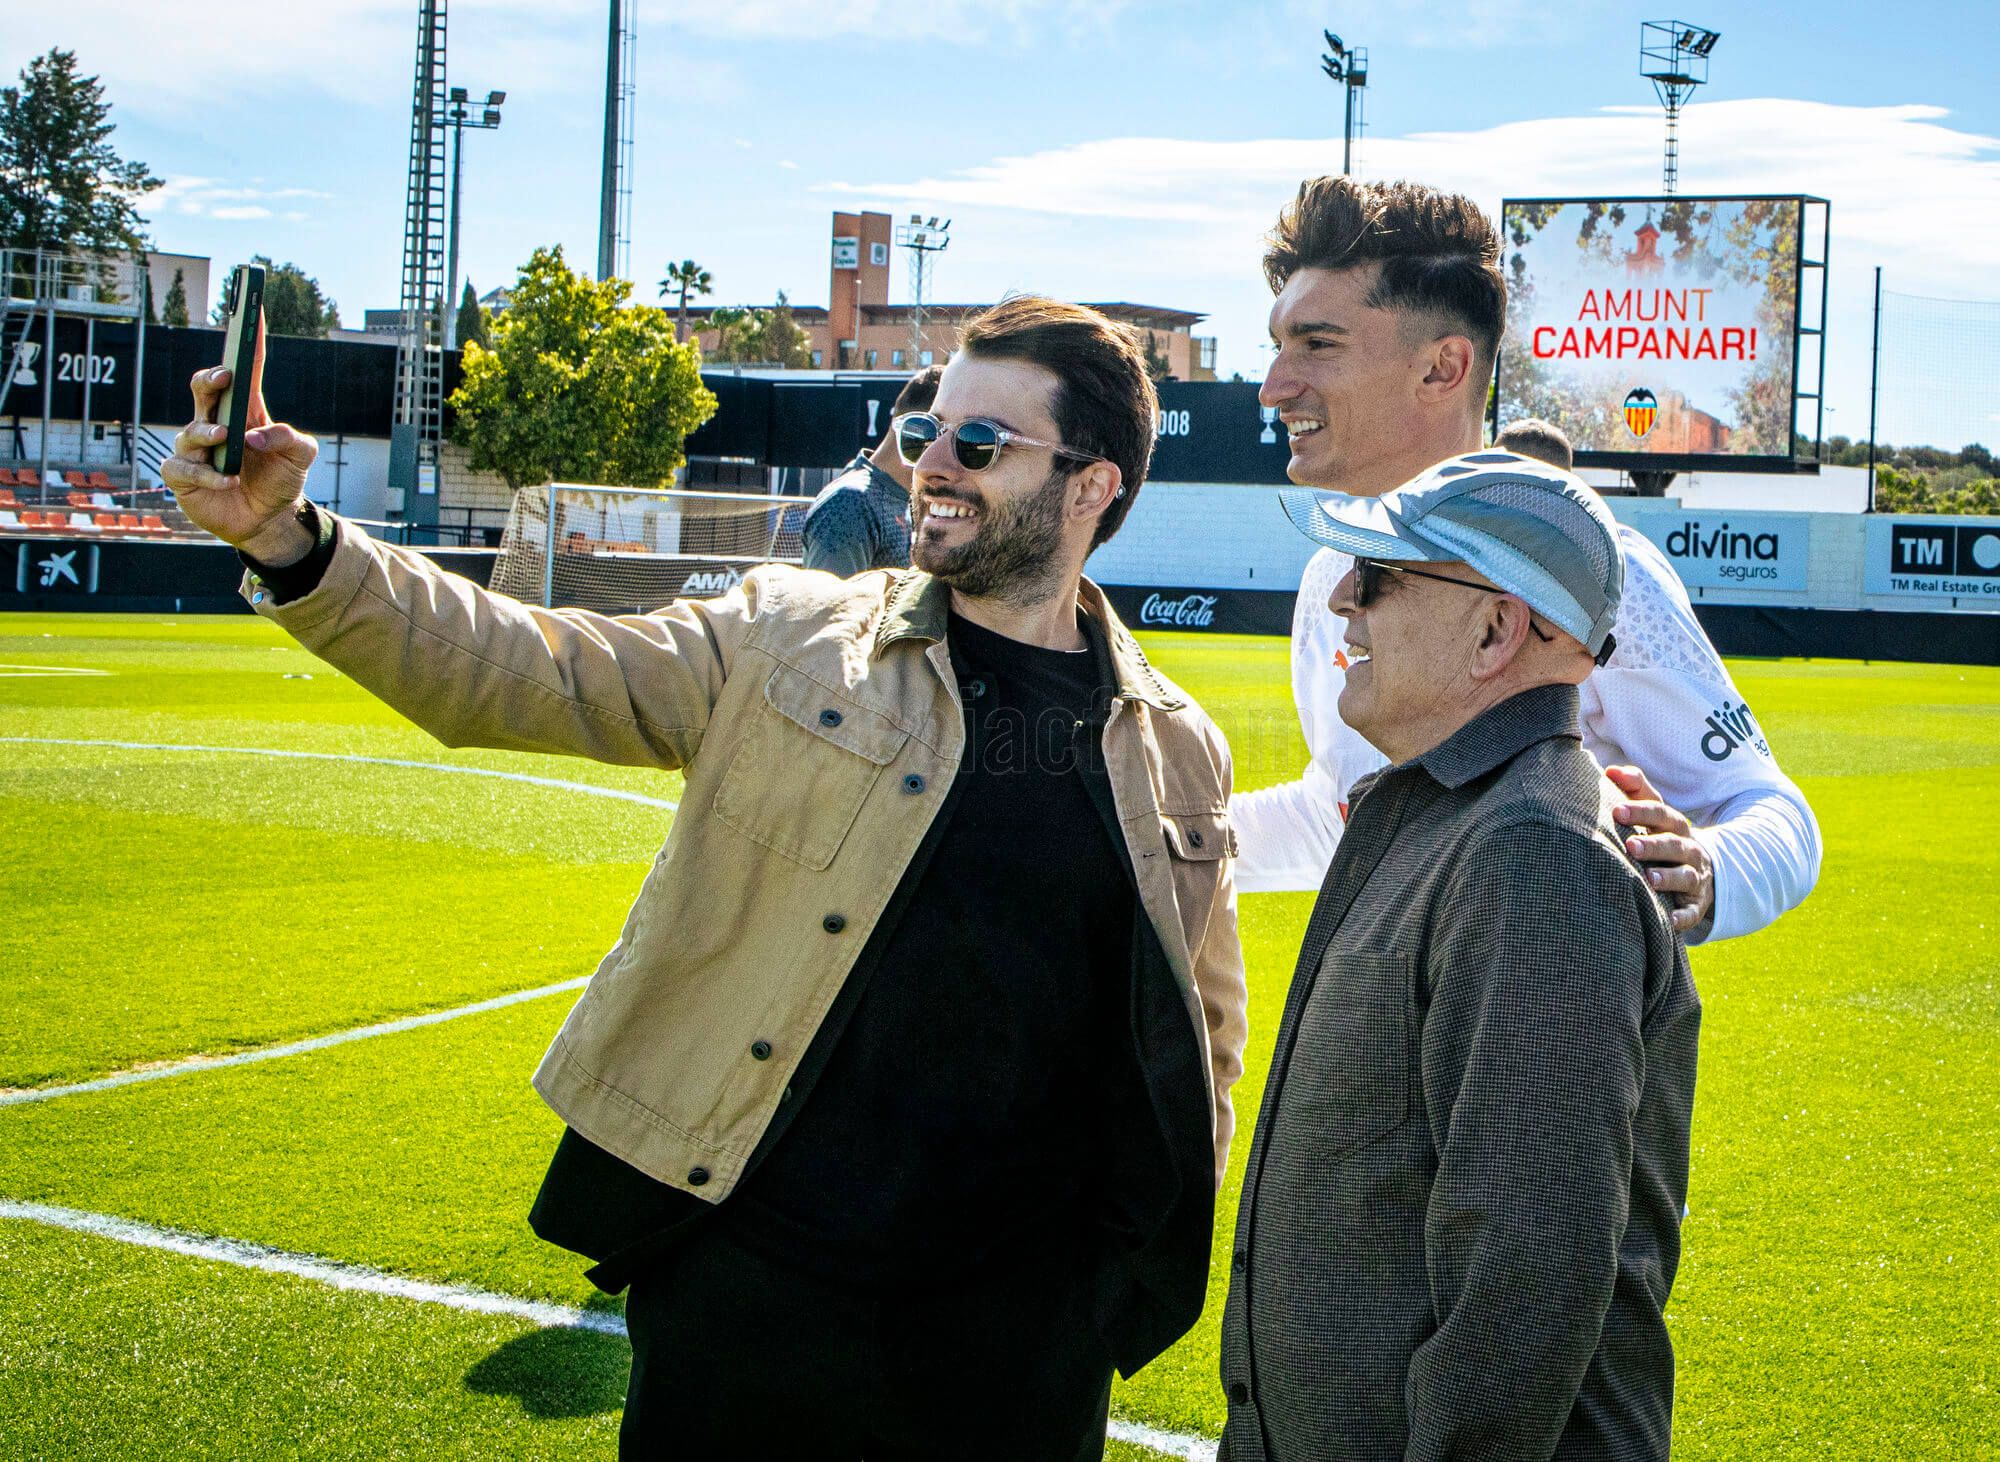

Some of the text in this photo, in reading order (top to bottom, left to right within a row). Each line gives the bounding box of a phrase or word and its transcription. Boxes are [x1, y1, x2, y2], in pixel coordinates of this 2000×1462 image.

[1578, 288, 1713, 322] AMUNT
[1532, 326, 1758, 361] CAMPANAR!
[57, 353, 116, 384] 2002
[1158, 410, 1190, 436] 008
[1666, 522, 1778, 560] divina
[1899, 537, 1943, 565] TM
[1718, 565, 1778, 582] seguros
[1891, 579, 1909, 590] TM
[1913, 581, 1938, 592] Real
[1943, 581, 1979, 594] Estate
